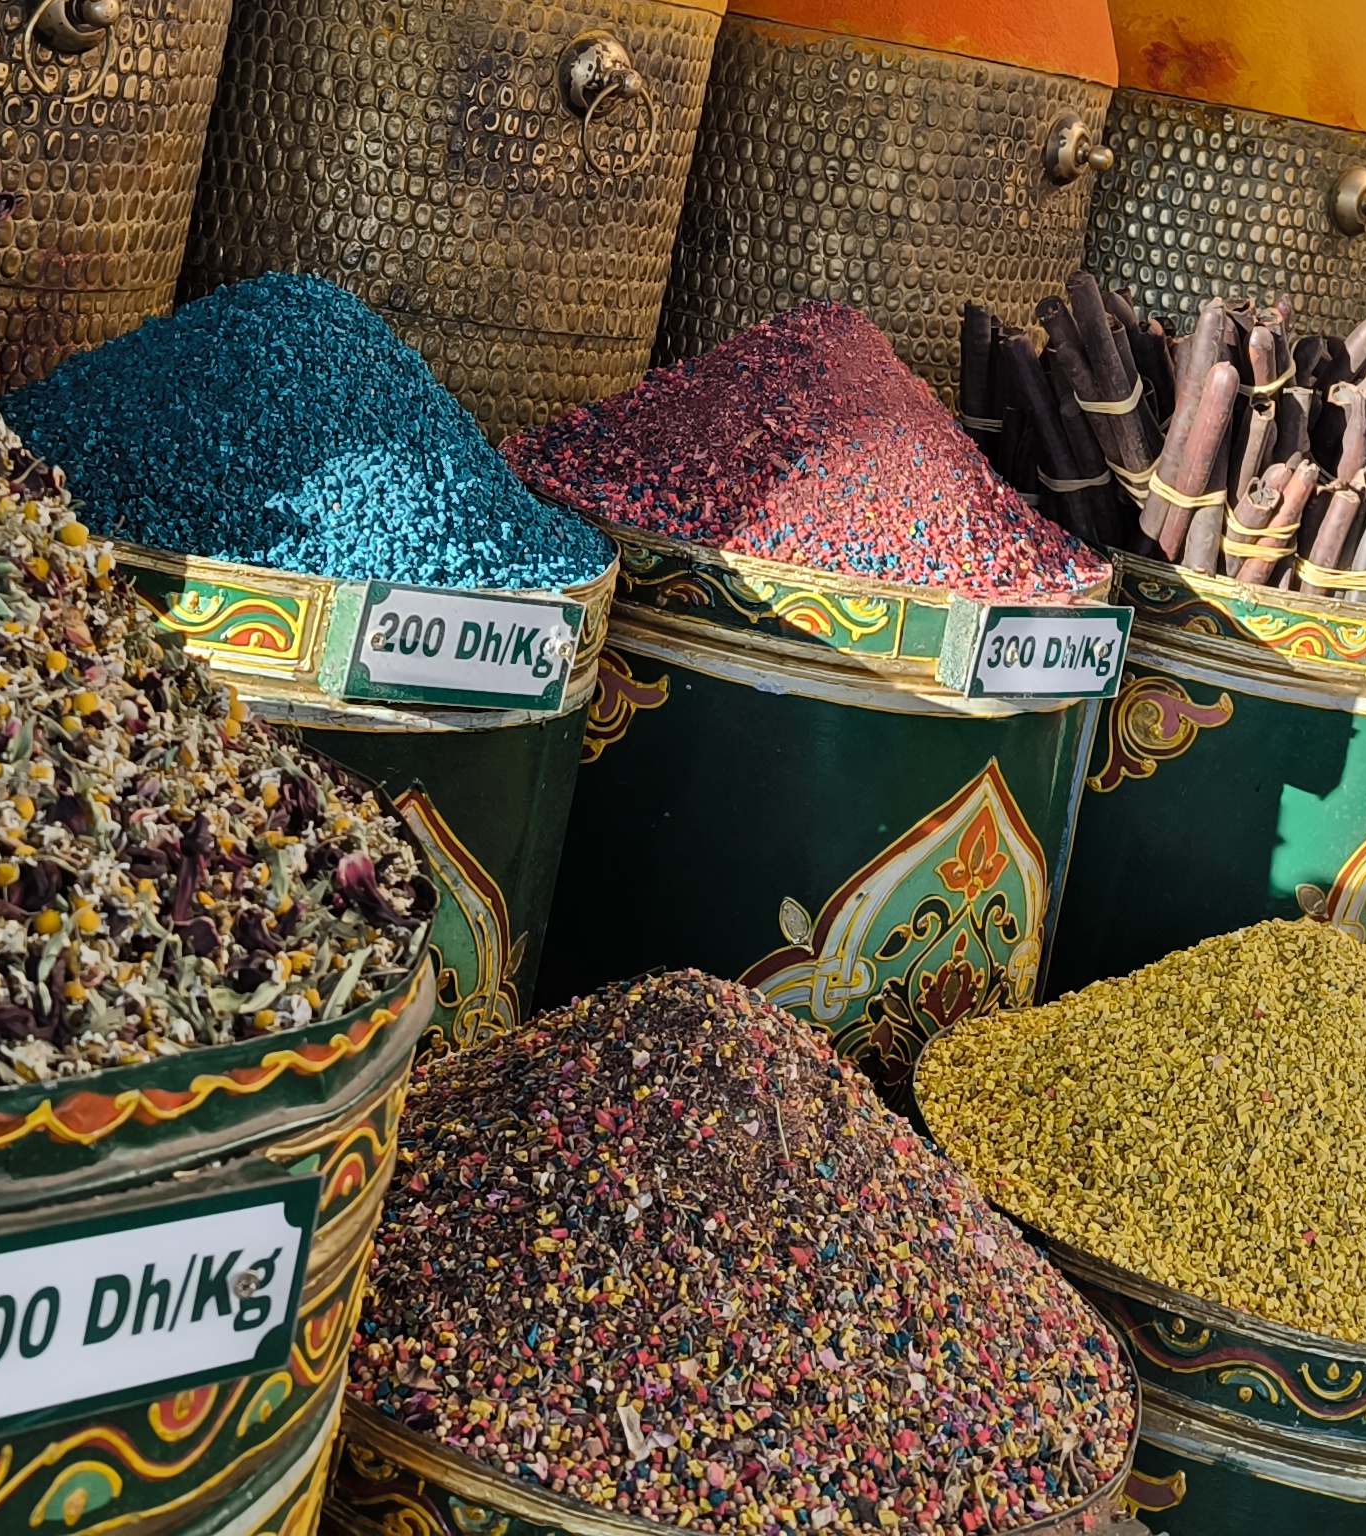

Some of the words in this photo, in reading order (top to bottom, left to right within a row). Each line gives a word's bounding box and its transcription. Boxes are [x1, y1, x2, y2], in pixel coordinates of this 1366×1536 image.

[372, 611, 446, 658] 200
[455, 620, 555, 679] Dh/Kg
[987, 634, 1036, 669] 300
[1043, 634, 1116, 677] Dh/Kg
[83, 1246, 283, 1346] Dh/Kg
